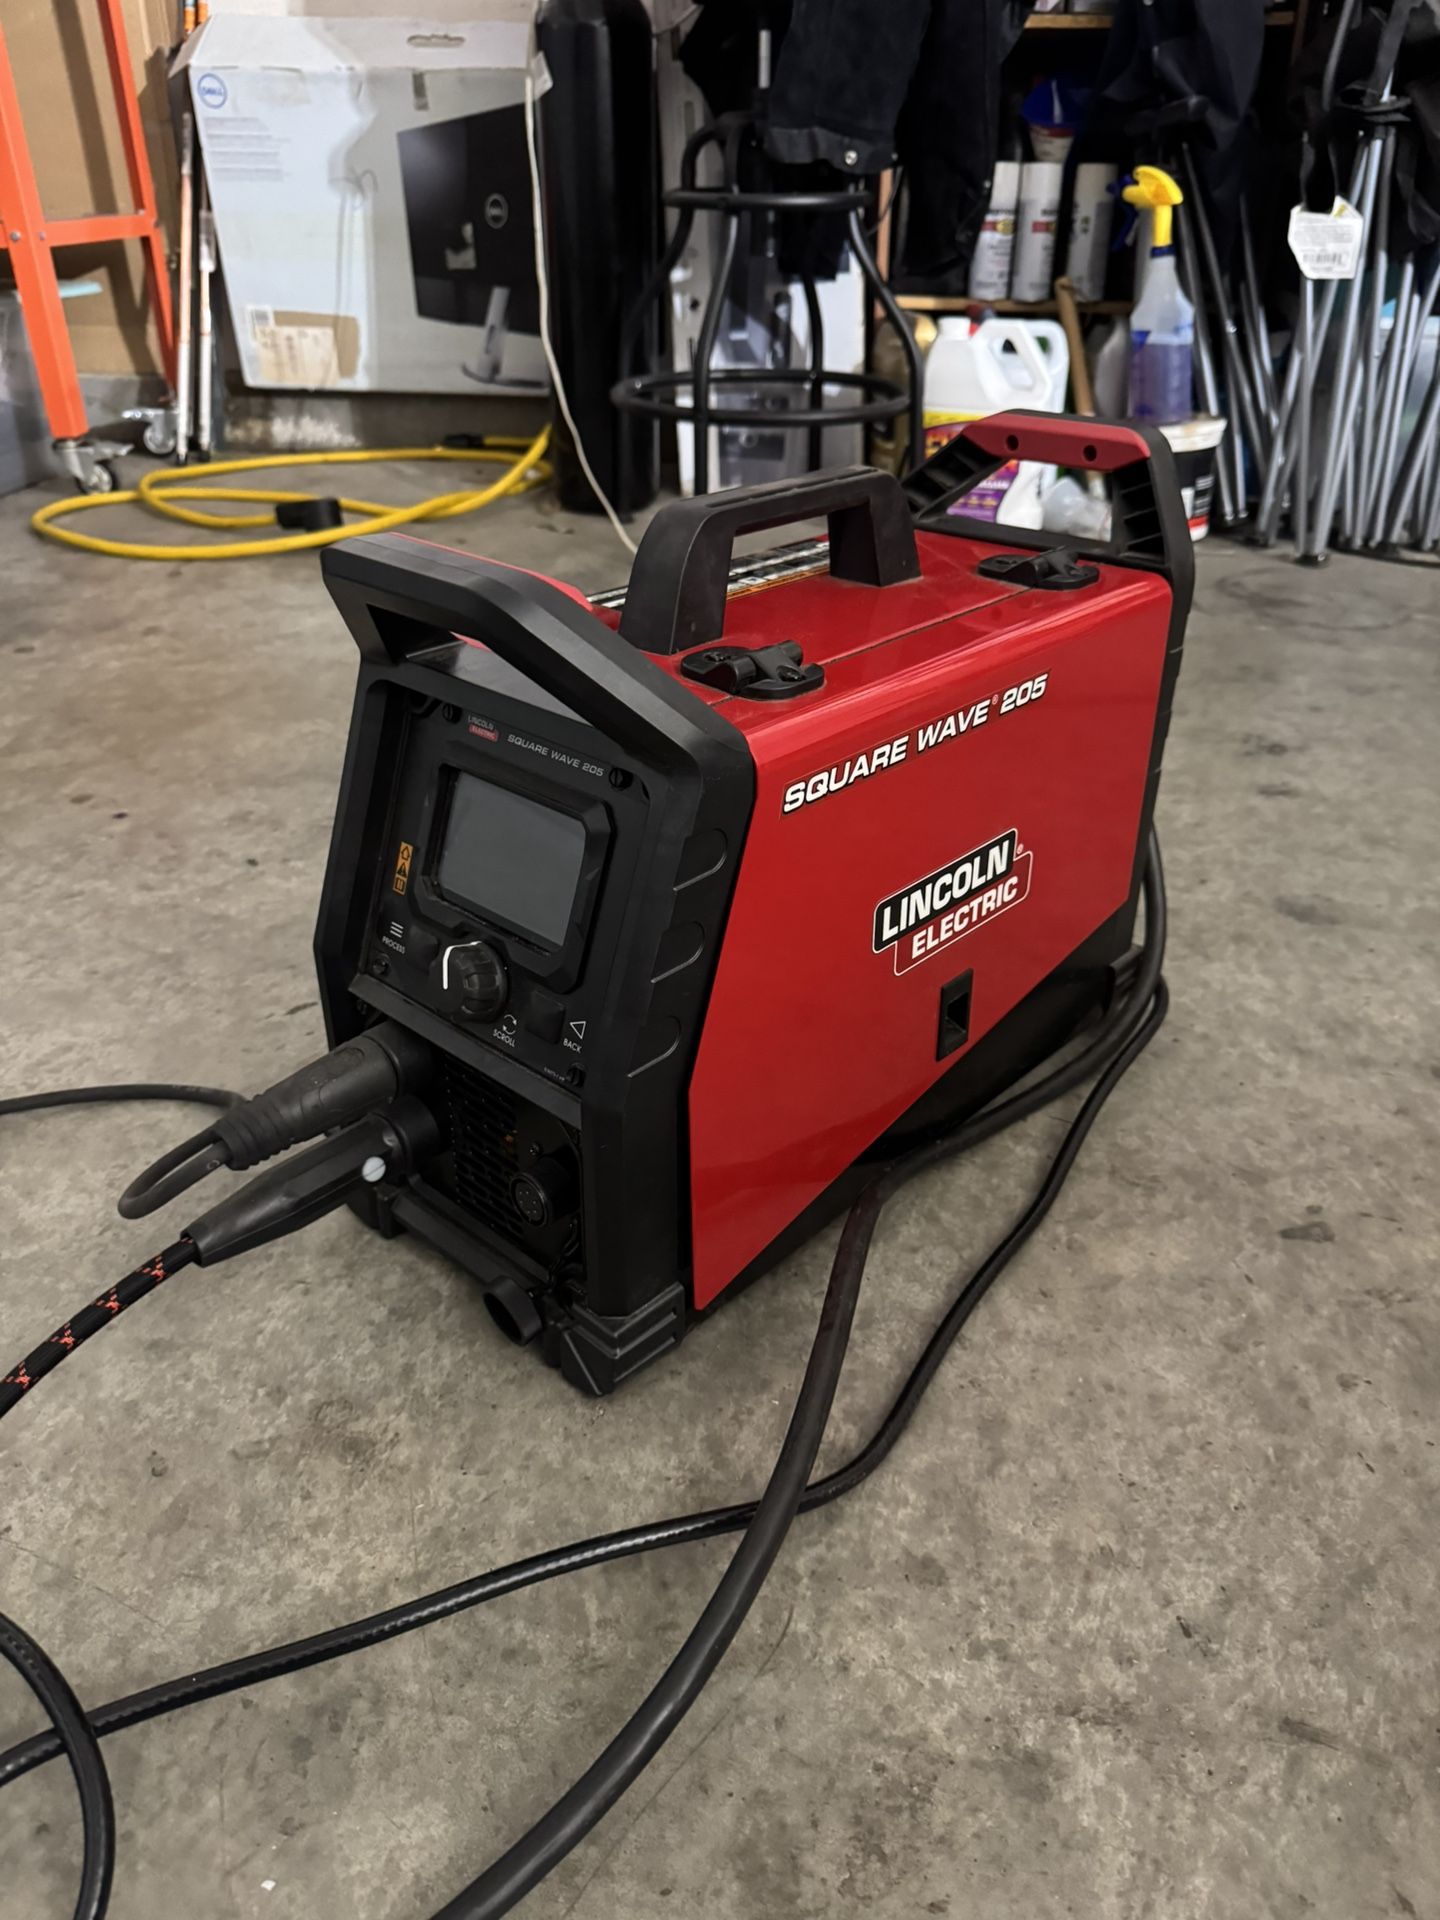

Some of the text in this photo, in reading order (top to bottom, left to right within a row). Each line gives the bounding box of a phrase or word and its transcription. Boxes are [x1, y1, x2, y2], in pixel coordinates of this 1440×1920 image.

[467, 715, 495, 731] LINCOLN
[507, 733, 605, 778] SQUARE WAVE 205
[782, 735, 909, 815] SQUARE
[999, 673, 1049, 716] 205
[882, 839, 1010, 942] LINCOLN
[911, 875, 1019, 960] ELECTRIC
[382, 935, 406, 955] PROCESS
[492, 1028, 516, 1048] SCROLL
[563, 1037, 582, 1053] BACK
